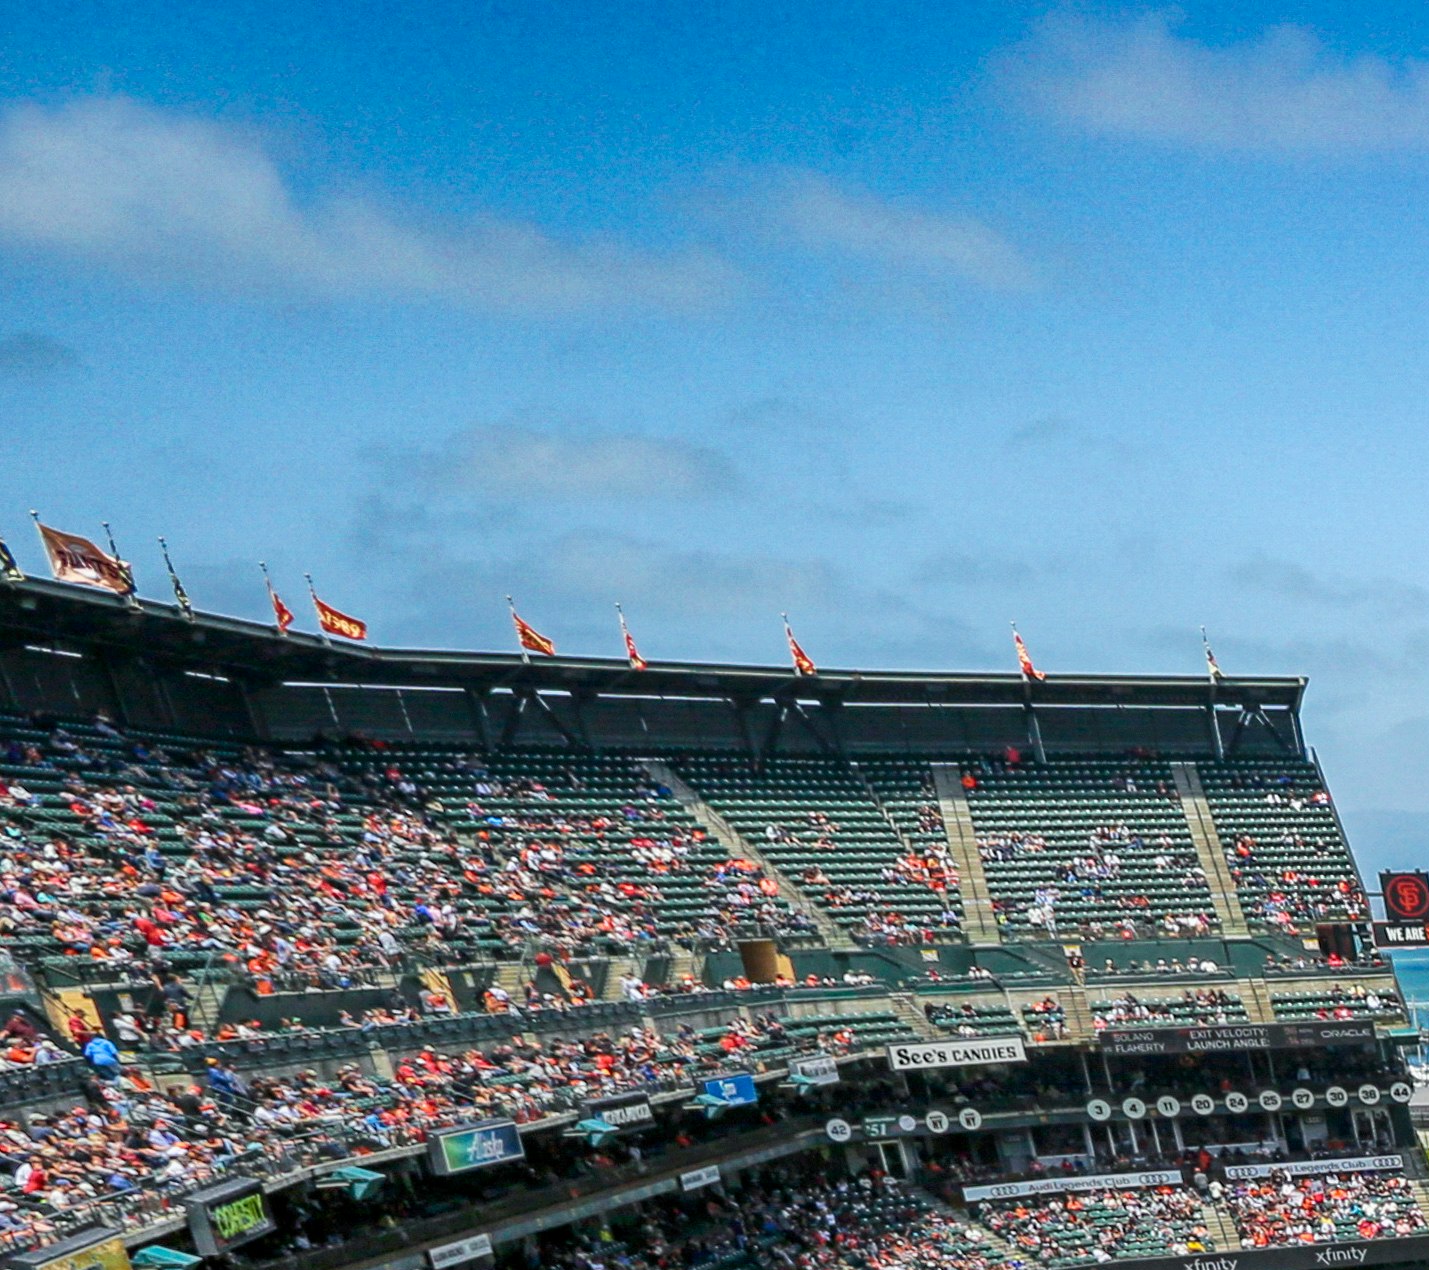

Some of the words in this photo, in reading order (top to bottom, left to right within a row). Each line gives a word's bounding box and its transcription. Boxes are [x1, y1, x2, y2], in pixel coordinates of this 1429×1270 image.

[1385, 927, 1404, 941] WE
[1405, 927, 1426, 941] ARE
[1113, 1031, 1154, 1042] SOLANO
[1189, 1029, 1212, 1040] EXIT
[1215, 1027, 1268, 1039] VELOCITY:
[1321, 1028, 1370, 1038] ORACLE
[1115, 1041, 1165, 1053] FLAHERTY
[1186, 1039, 1223, 1050] LAUNCH
[1225, 1037, 1270, 1049] ANGLE:
[897, 1048, 948, 1066] See's
[952, 1046, 1017, 1063] CANDIES
[1268, 1163, 1293, 1174] Adi
[1295, 1161, 1338, 1174] Legends
[1341, 1158, 1366, 1169] Club
[1028, 1181, 1053, 1195] Audi
[1106, 1176, 1130, 1188] Club
[1316, 1247, 1367, 1266] xfinity
